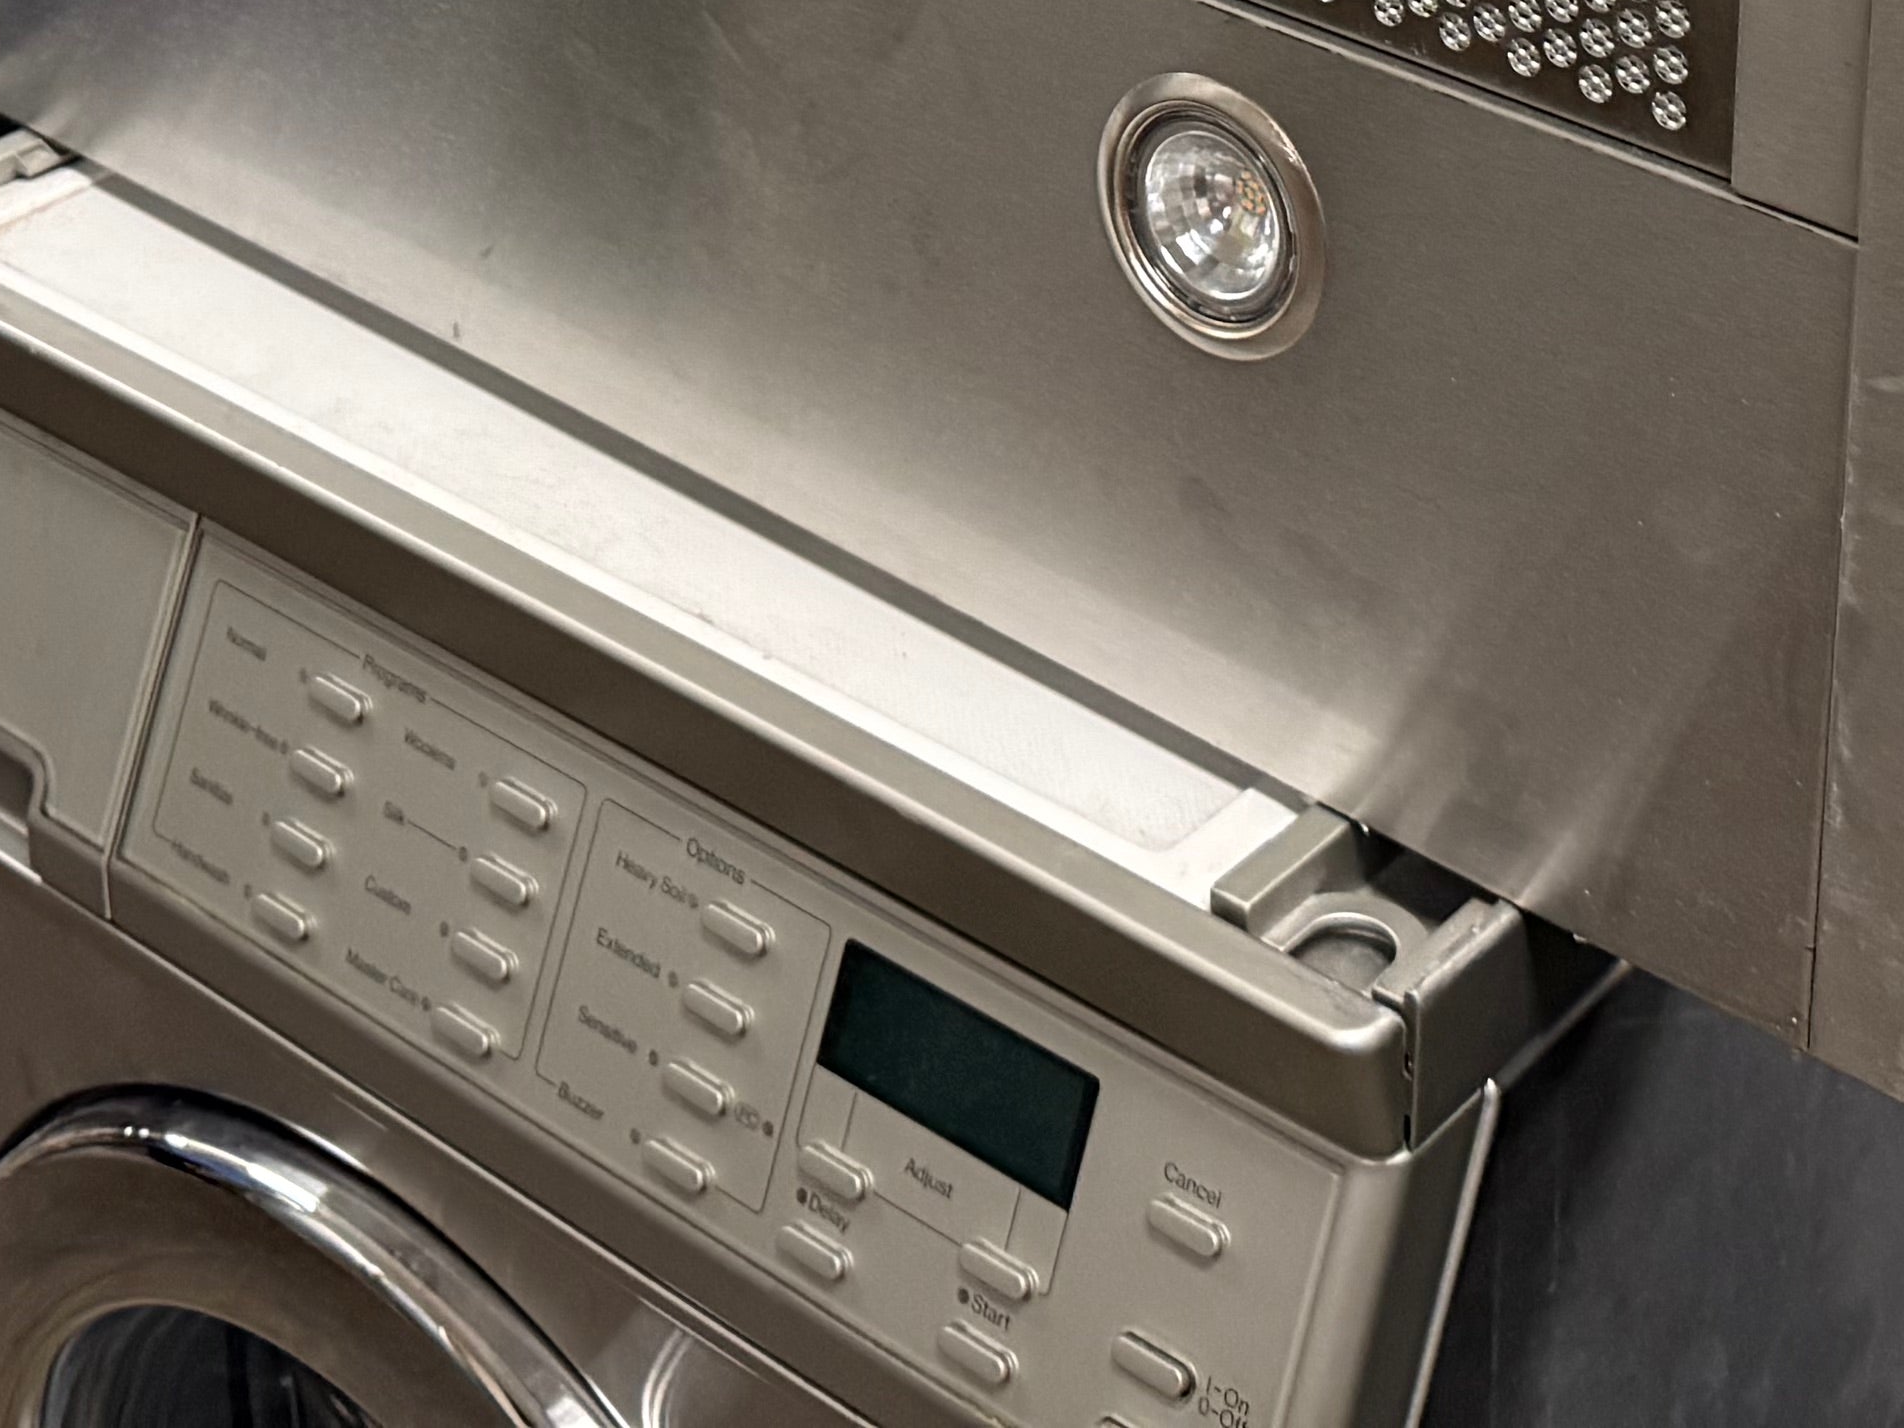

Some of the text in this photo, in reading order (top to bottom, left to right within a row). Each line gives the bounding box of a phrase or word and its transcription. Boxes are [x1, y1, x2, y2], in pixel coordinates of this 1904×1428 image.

[362, 653, 427, 704] Programs
[615, 850, 658, 890] Heavy
[686, 837, 746, 886] Options
[364, 874, 412, 916] Custom
[346, 947, 388, 985] Master
[596, 927, 662, 979] Extended
[578, 1004, 638, 1055] Sensitive
[558, 1079, 605, 1121] Buzzer
[903, 1157, 954, 1200] Adjust
[1163, 1161, 1223, 1209] Cancel
[807, 1191, 852, 1234] Delay
[970, 1295, 1012, 1332] Start
